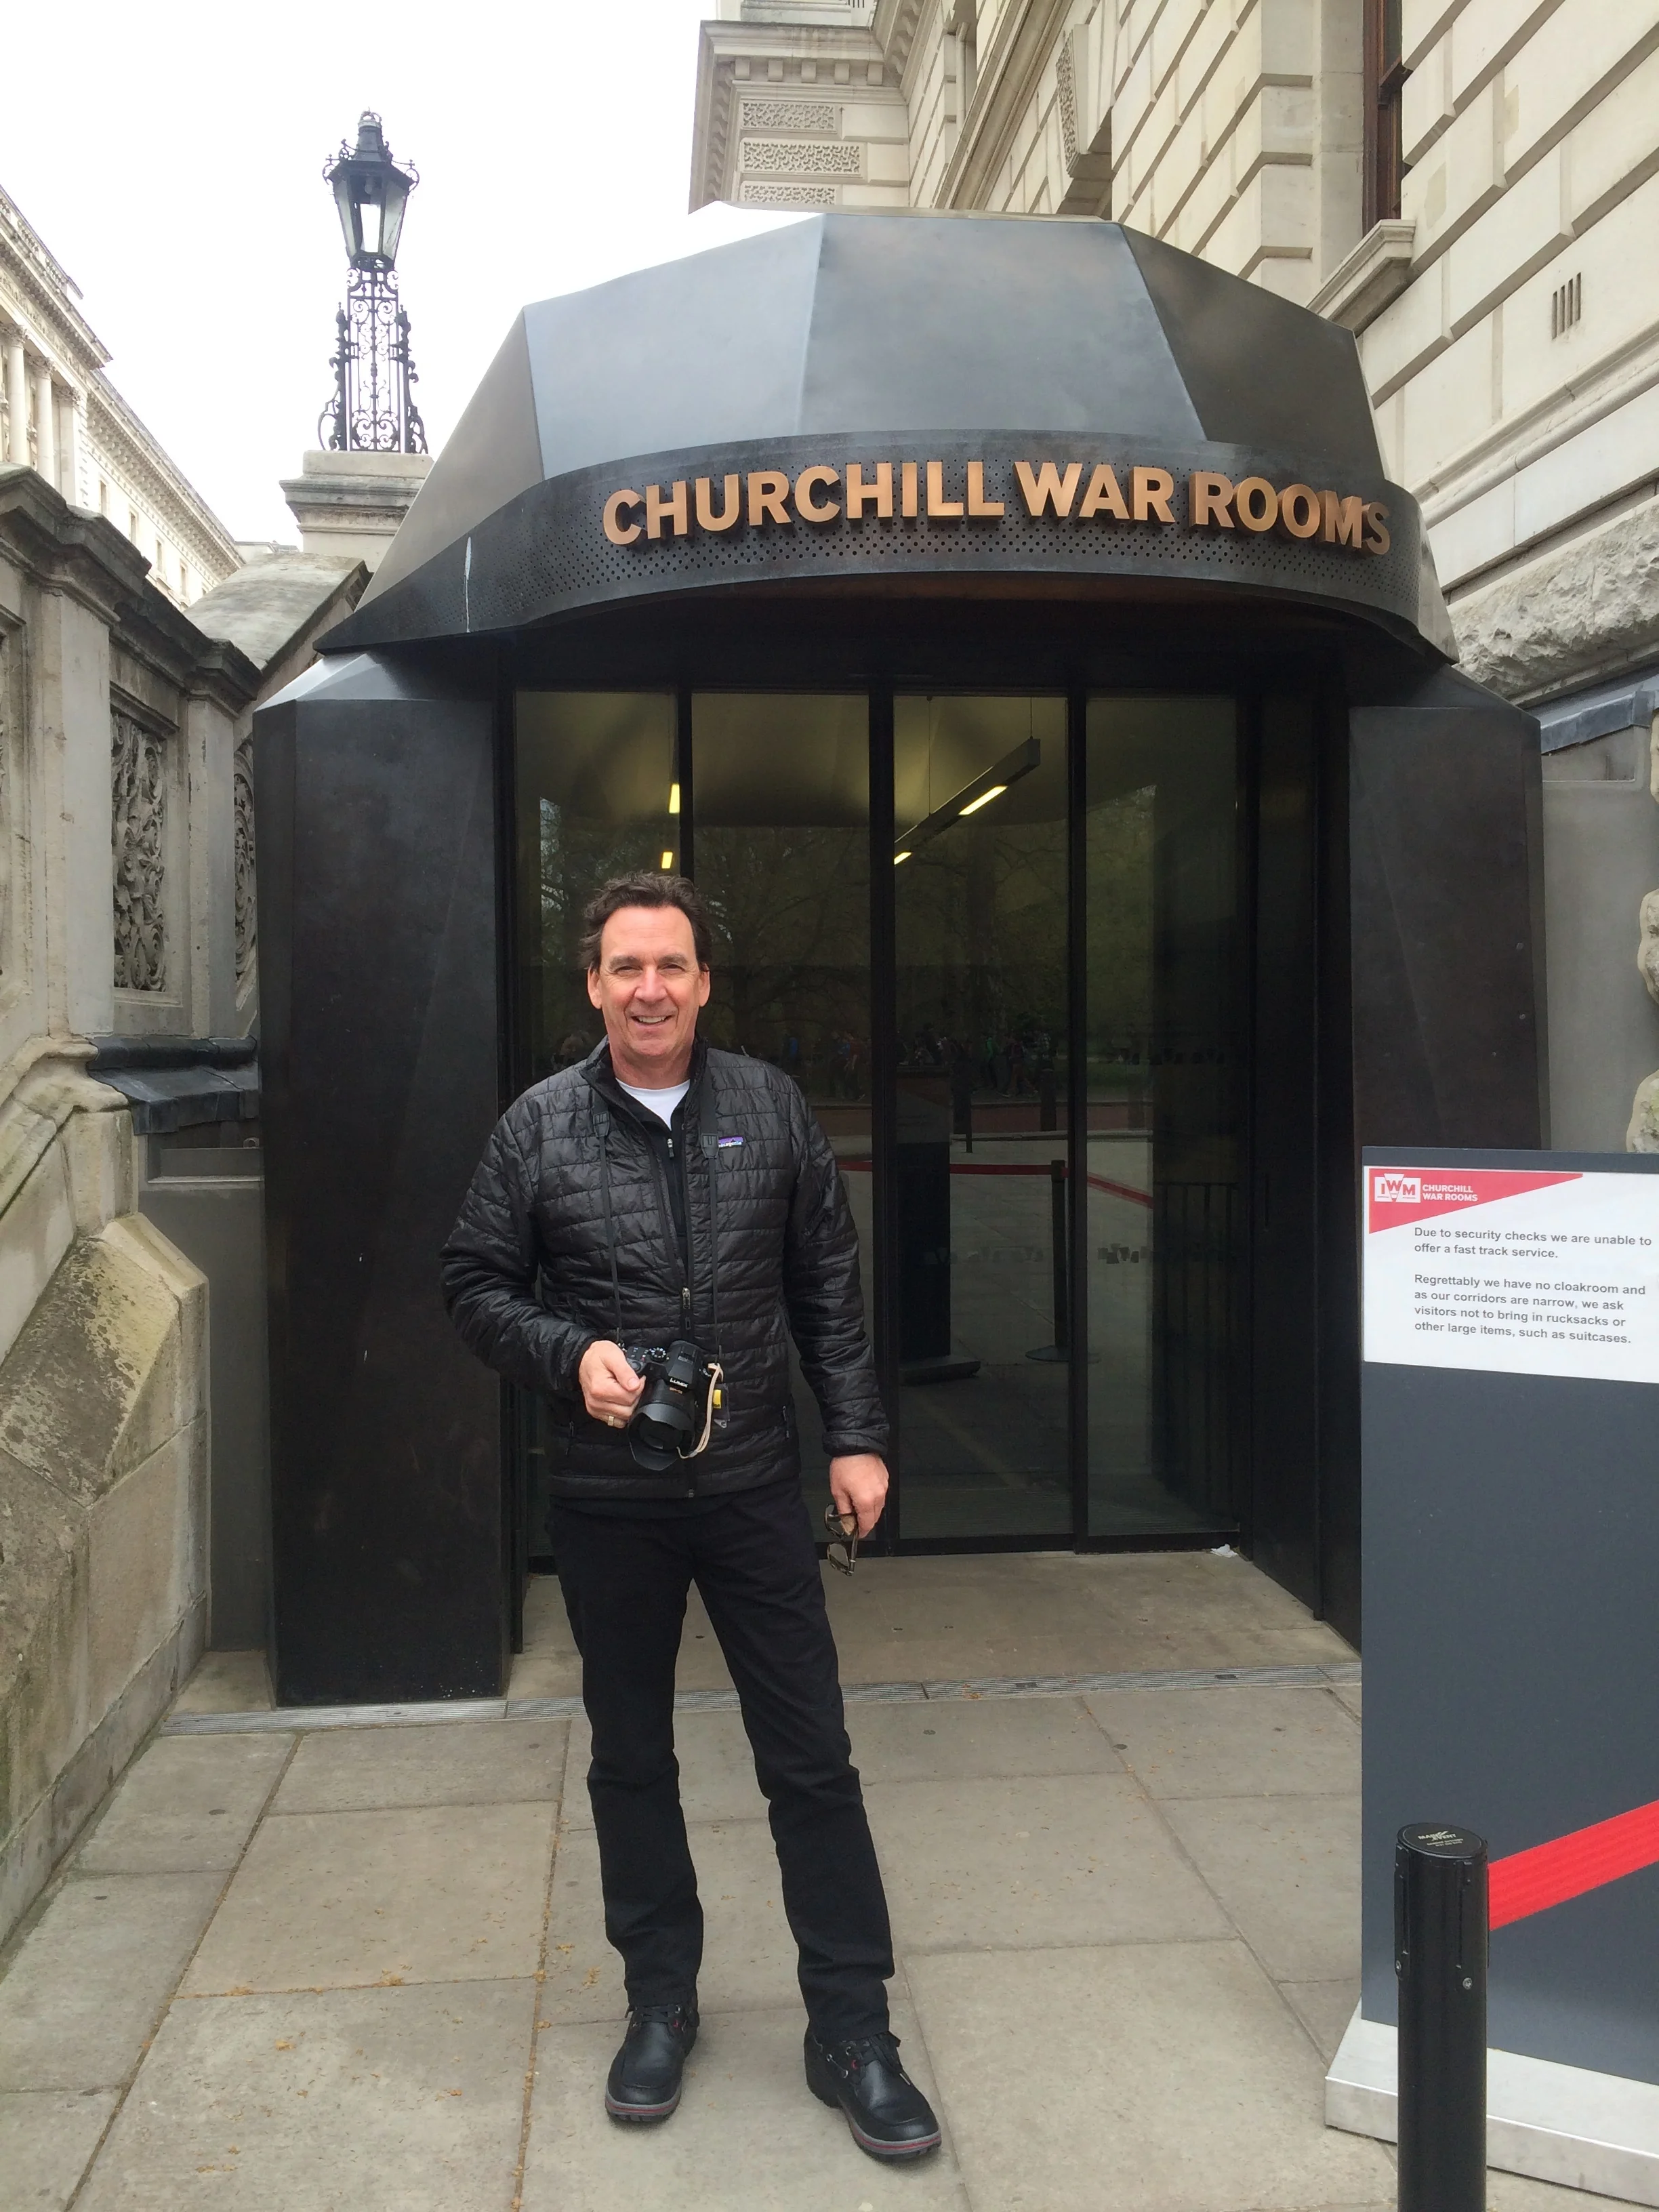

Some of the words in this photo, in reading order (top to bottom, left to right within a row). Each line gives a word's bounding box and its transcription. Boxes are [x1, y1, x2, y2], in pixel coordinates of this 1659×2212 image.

[603, 461, 1004, 546] CHURCHILL
[1014, 462, 1175, 523] WAR
[1189, 471, 1390, 555] ROOMS
[1380, 1180, 1416, 1195] IWM
[1422, 1184, 1473, 1193] CHURCHILL
[1422, 1193, 1443, 1201] WAR
[1445, 1193, 1478, 1202] ROOMS
[1414, 1227, 1437, 1237] Due
[1440, 1229, 1451, 1237] to
[1454, 1229, 1502, 1242] security
[1505, 1231, 1547, 1242] checks
[1571, 1235, 1591, 1244] are
[1594, 1235, 1635, 1245] unable
[1639, 1237, 1652, 1246] to
[1414, 1244, 1441, 1252] offer
[1454, 1244, 1476, 1254] fast
[1479, 1246, 1509, 1256] track
[1512, 1248, 1558, 1258] service.
[1414, 1274, 1480, 1288] Regrettably
[1504, 1279, 1532, 1289] have
[1554, 1282, 1618, 1293] cloakroom
[1622, 1286, 1645, 1294] and
[1431, 1292, 1450, 1300] our
[1454, 1293, 1507, 1304] corridors
[1533, 1298, 1578, 1309] narrow,
[1581, 1300, 1598, 1309] we
[1602, 1300, 1624, 1310] ask
[1414, 1306, 1456, 1317] visitors
[1460, 1309, 1479, 1318] not
[1483, 1310, 1494, 1319] to
[1498, 1311, 1528, 1323] bring
[1532, 1312, 1542, 1321] in
[1547, 1314, 1609, 1326] rucksacks
[1612, 1318, 1626, 1326] or
[1414, 1322, 1445, 1332] other
[1448, 1324, 1477, 1335] large
[1480, 1325, 1515, 1337] items,
[1519, 1328, 1548, 1338] such
[1551, 1331, 1565, 1339] as
[1569, 1331, 1631, 1343] suitcases.
[670, 1378, 688, 1387] LUMIX
